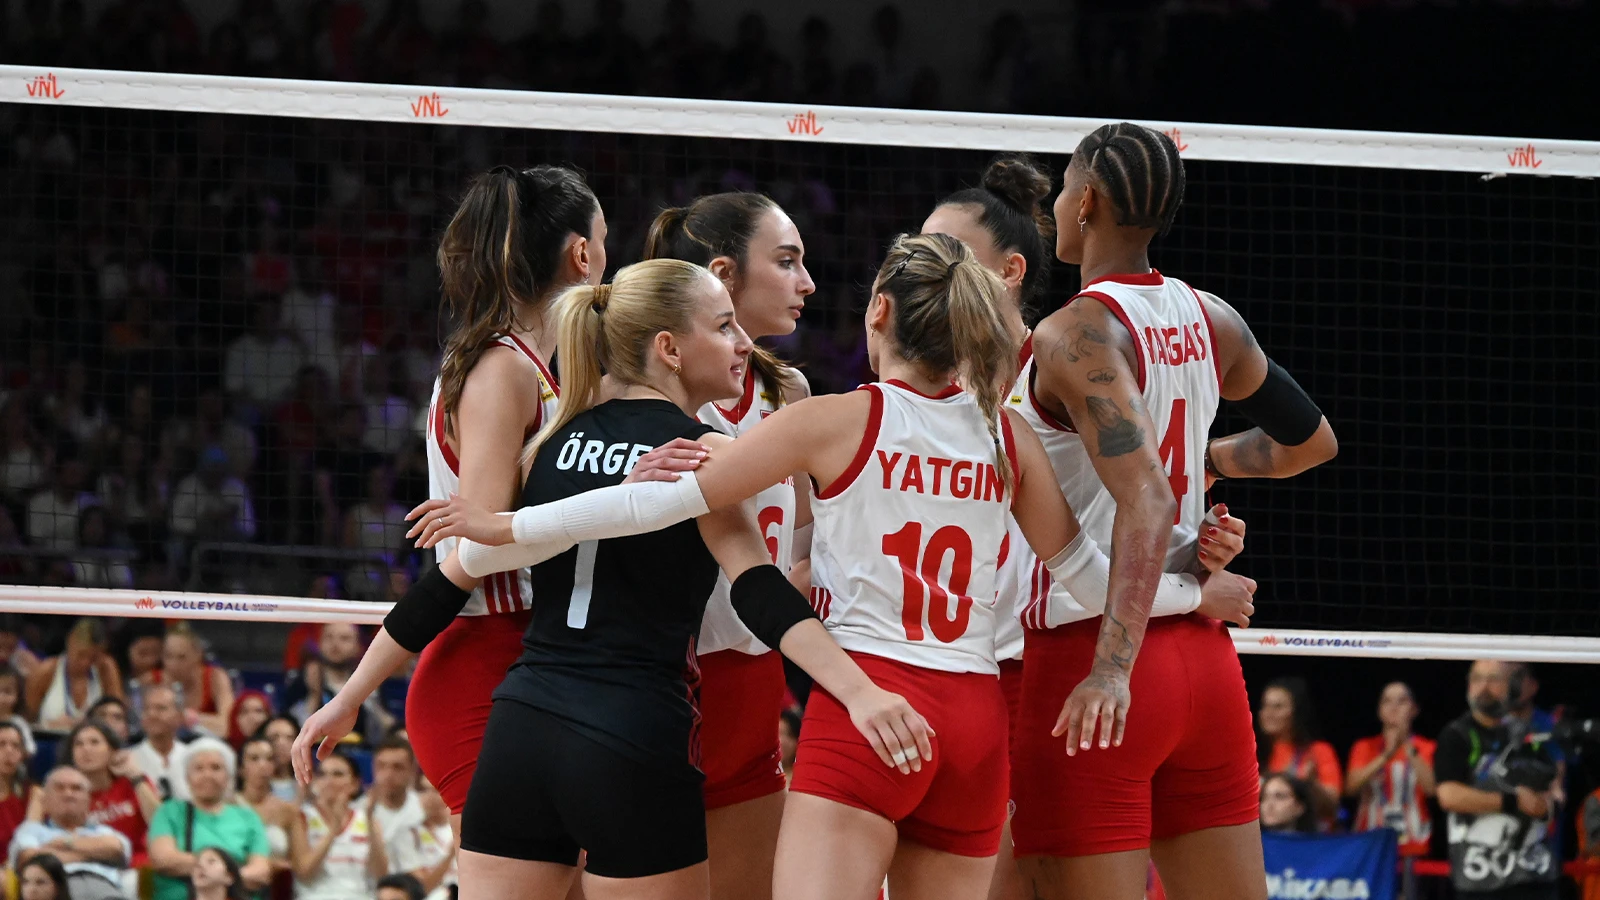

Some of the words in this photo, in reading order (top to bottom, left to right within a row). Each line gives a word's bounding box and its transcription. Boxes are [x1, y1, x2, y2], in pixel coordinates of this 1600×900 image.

[411, 92, 449, 118] VNL
[876, 449, 1005, 503] YATGIN
[881, 521, 973, 643] 10
[161, 599, 249, 611] VOLLEYBALL
[1284, 637, 1365, 648] VOLLEYBALL
